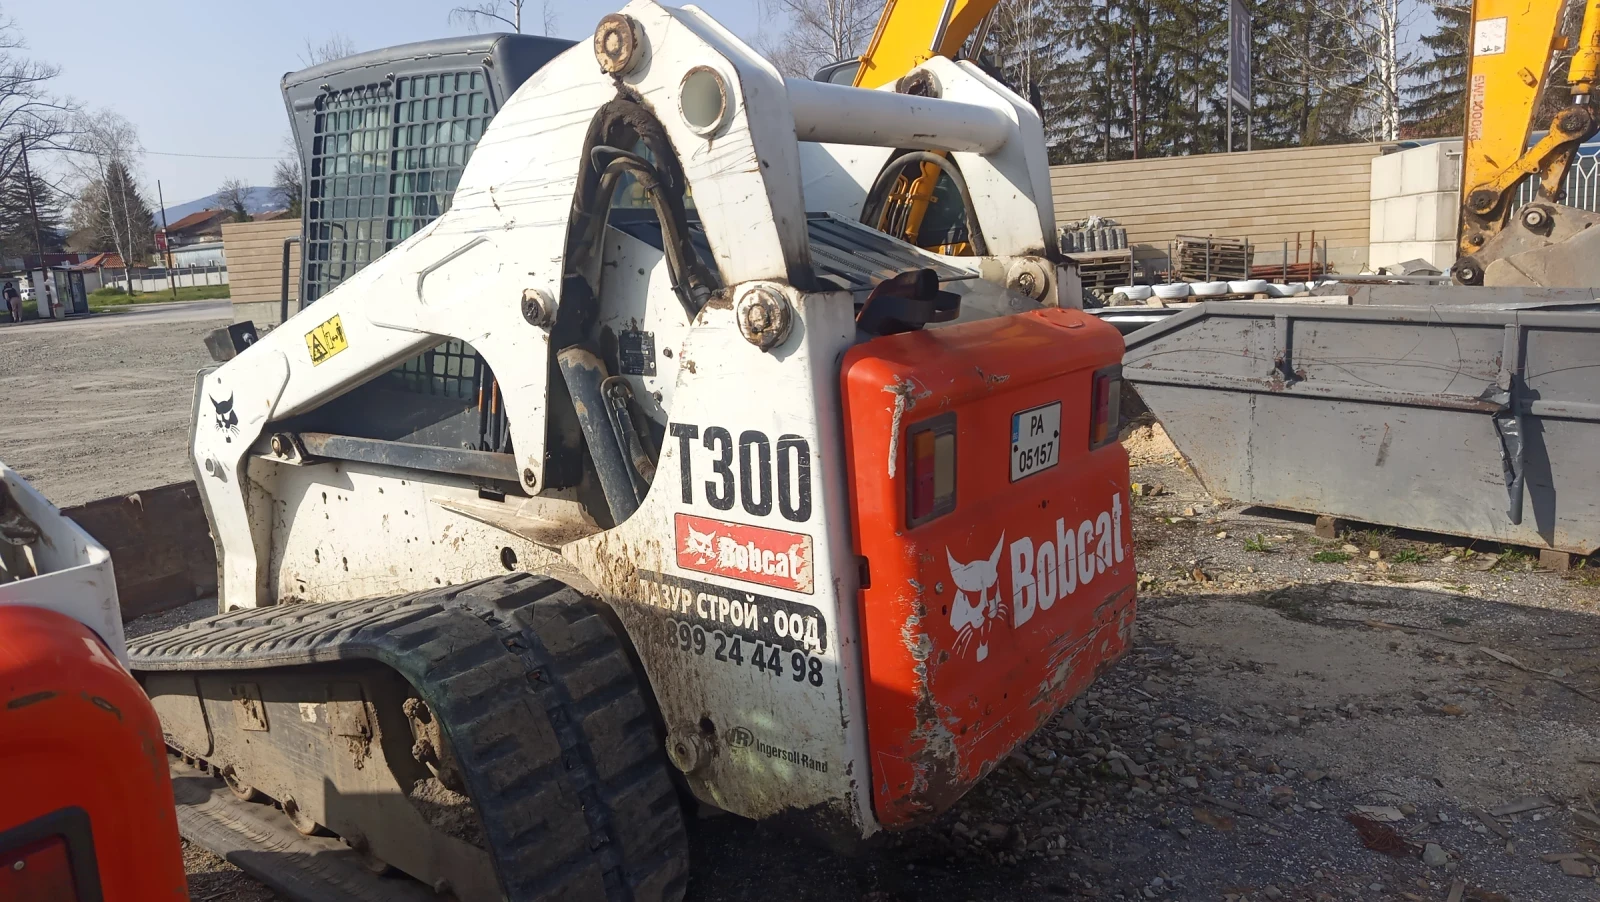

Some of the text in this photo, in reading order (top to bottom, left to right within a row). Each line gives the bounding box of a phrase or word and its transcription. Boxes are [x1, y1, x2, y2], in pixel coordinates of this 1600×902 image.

[1030, 413, 1044, 437] PA
[669, 422, 812, 523] T300
[1019, 441, 1053, 473] 05157
[718, 536, 801, 580] Bobcat
[1010, 492, 1124, 630] Bobcat
[696, 593, 759, 632] СТРОЙ
[774, 610, 822, 652] ООД
[714, 631, 744, 667] 24
[751, 644, 784, 677] 44
[792, 652, 824, 688] 98
